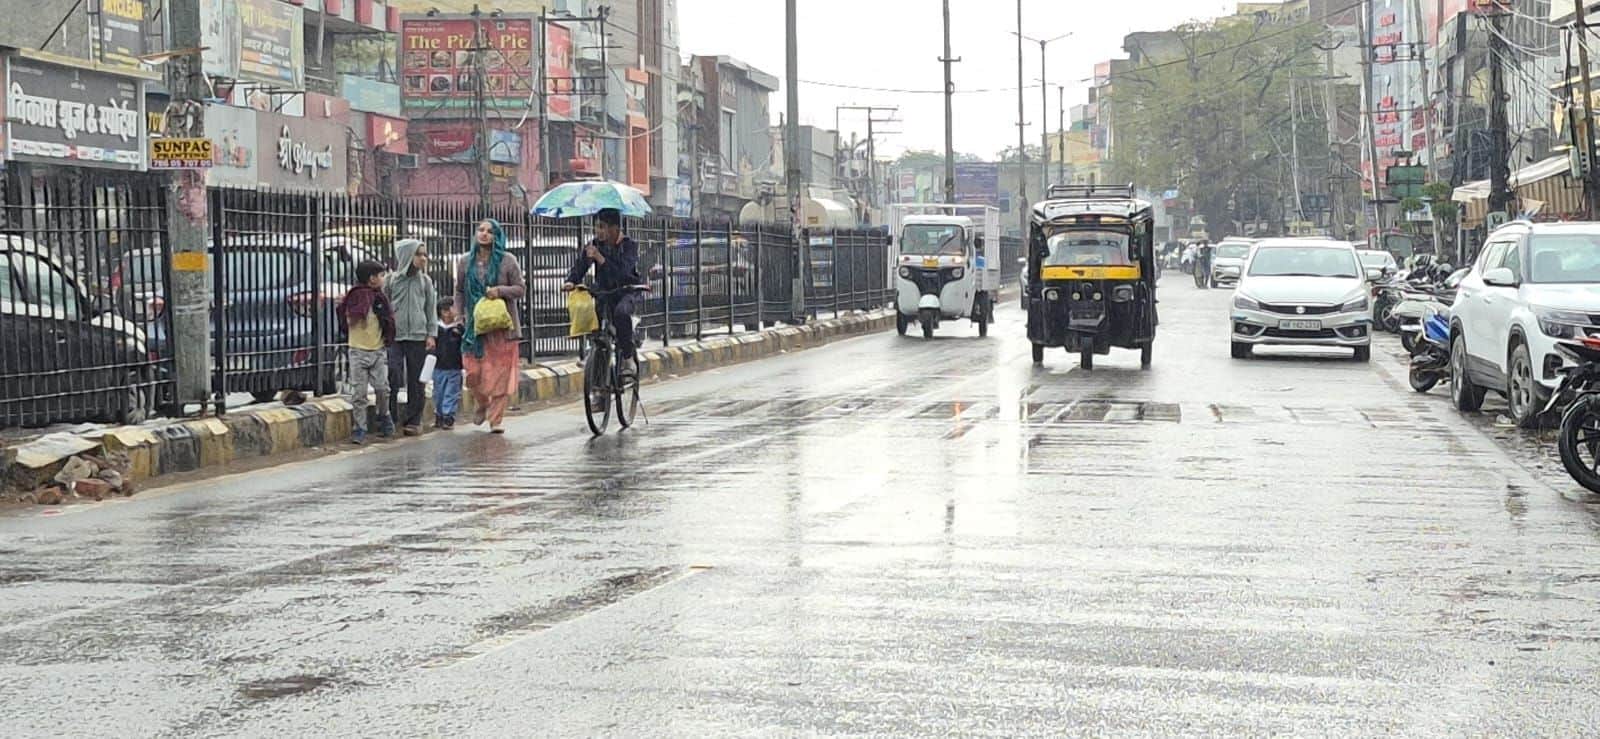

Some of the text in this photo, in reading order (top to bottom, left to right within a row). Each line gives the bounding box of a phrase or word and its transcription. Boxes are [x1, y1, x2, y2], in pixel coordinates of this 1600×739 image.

[408, 35, 441, 49] The
[501, 33, 528, 49] Pie
[8, 82, 57, 128] विकास
[87, 104, 98, 133] &
[153, 140, 211, 152] SUNPAC
